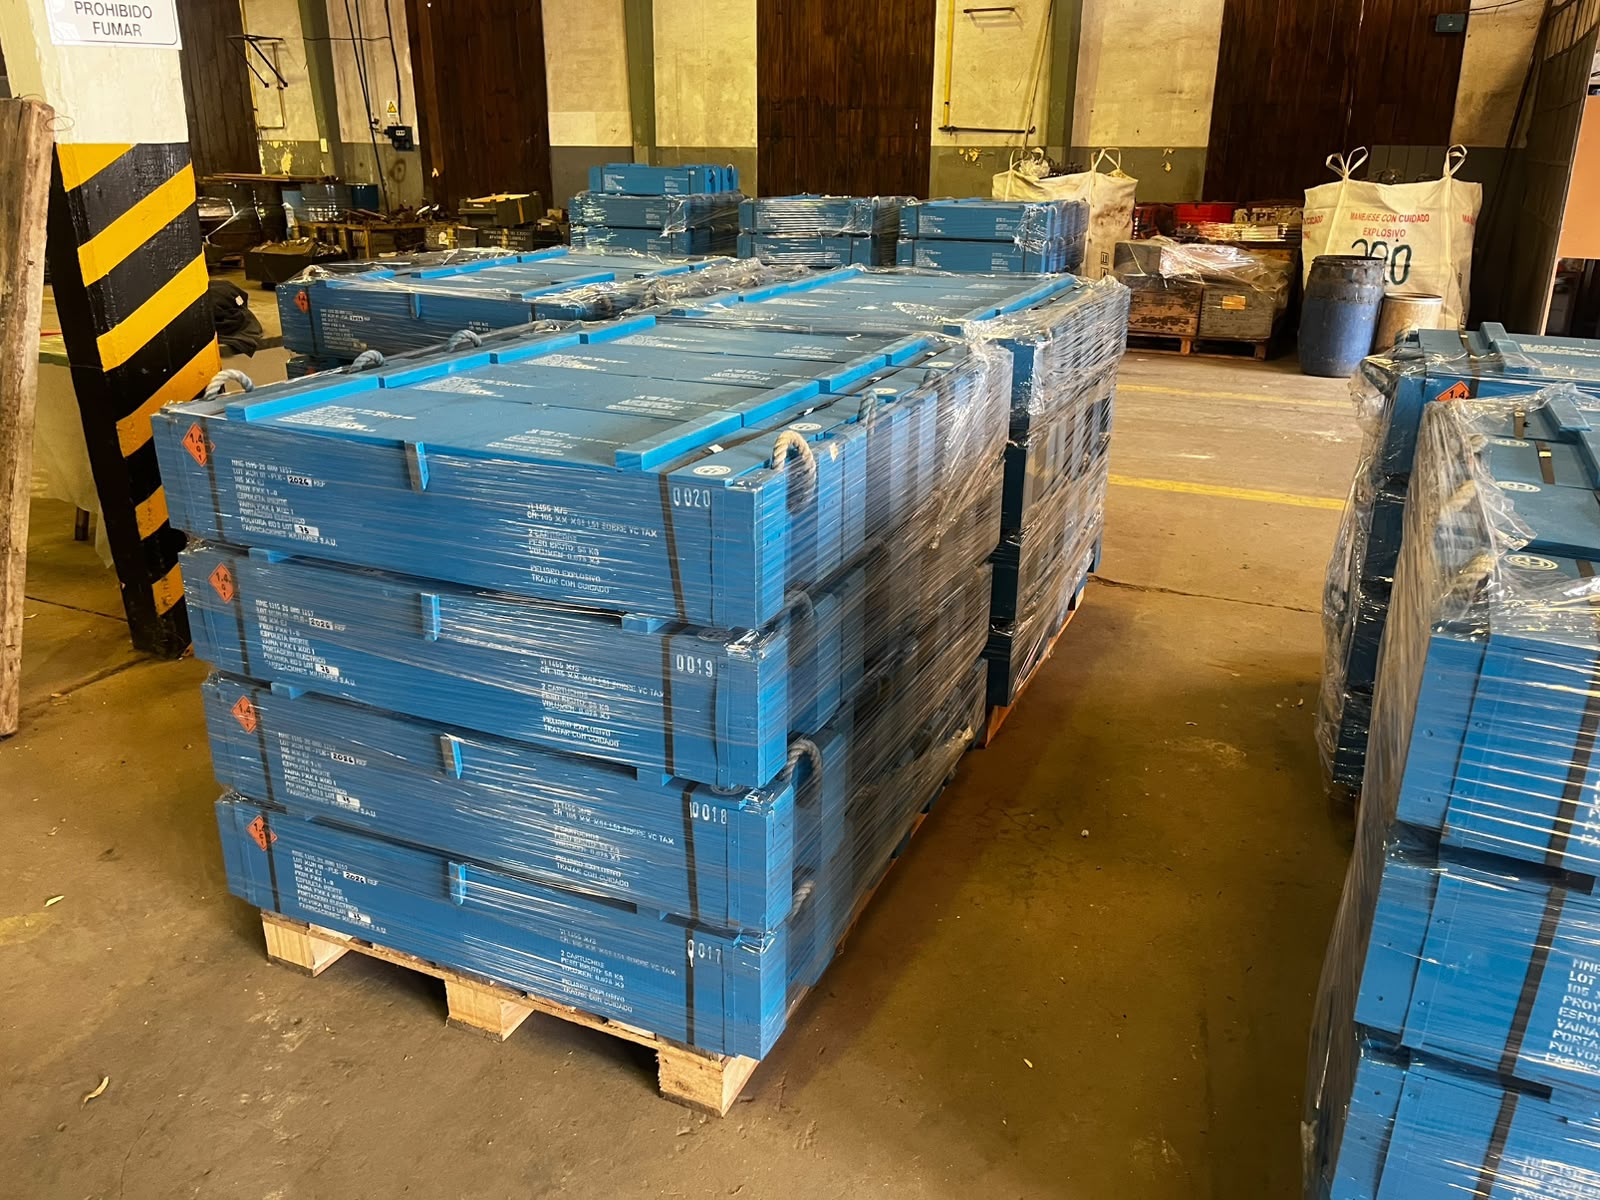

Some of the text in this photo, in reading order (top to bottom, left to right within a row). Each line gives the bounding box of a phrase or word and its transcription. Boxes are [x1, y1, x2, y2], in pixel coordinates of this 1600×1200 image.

[74, 1, 152, 19] PROHIBIDO
[92, 21, 142, 37] FUMAR
[1350, 212, 1430, 223] MANEJESE CON CUIDADO
[1363, 227, 1406, 238] EXPLOSIVO
[673, 487, 711, 507] 0020
[676, 654, 713, 678] 0019
[690, 801, 727, 824] 0018
[688, 939, 721, 967] 0017
[1569, 970, 1596, 985] LOT
[1568, 983, 1590, 997] 105
[1562, 995, 1600, 1012] PROY
[1558, 1006, 1600, 1026] ESPO
[1557, 1018, 1600, 1038] VAINA
[1552, 1029, 1600, 1050] PORTA
